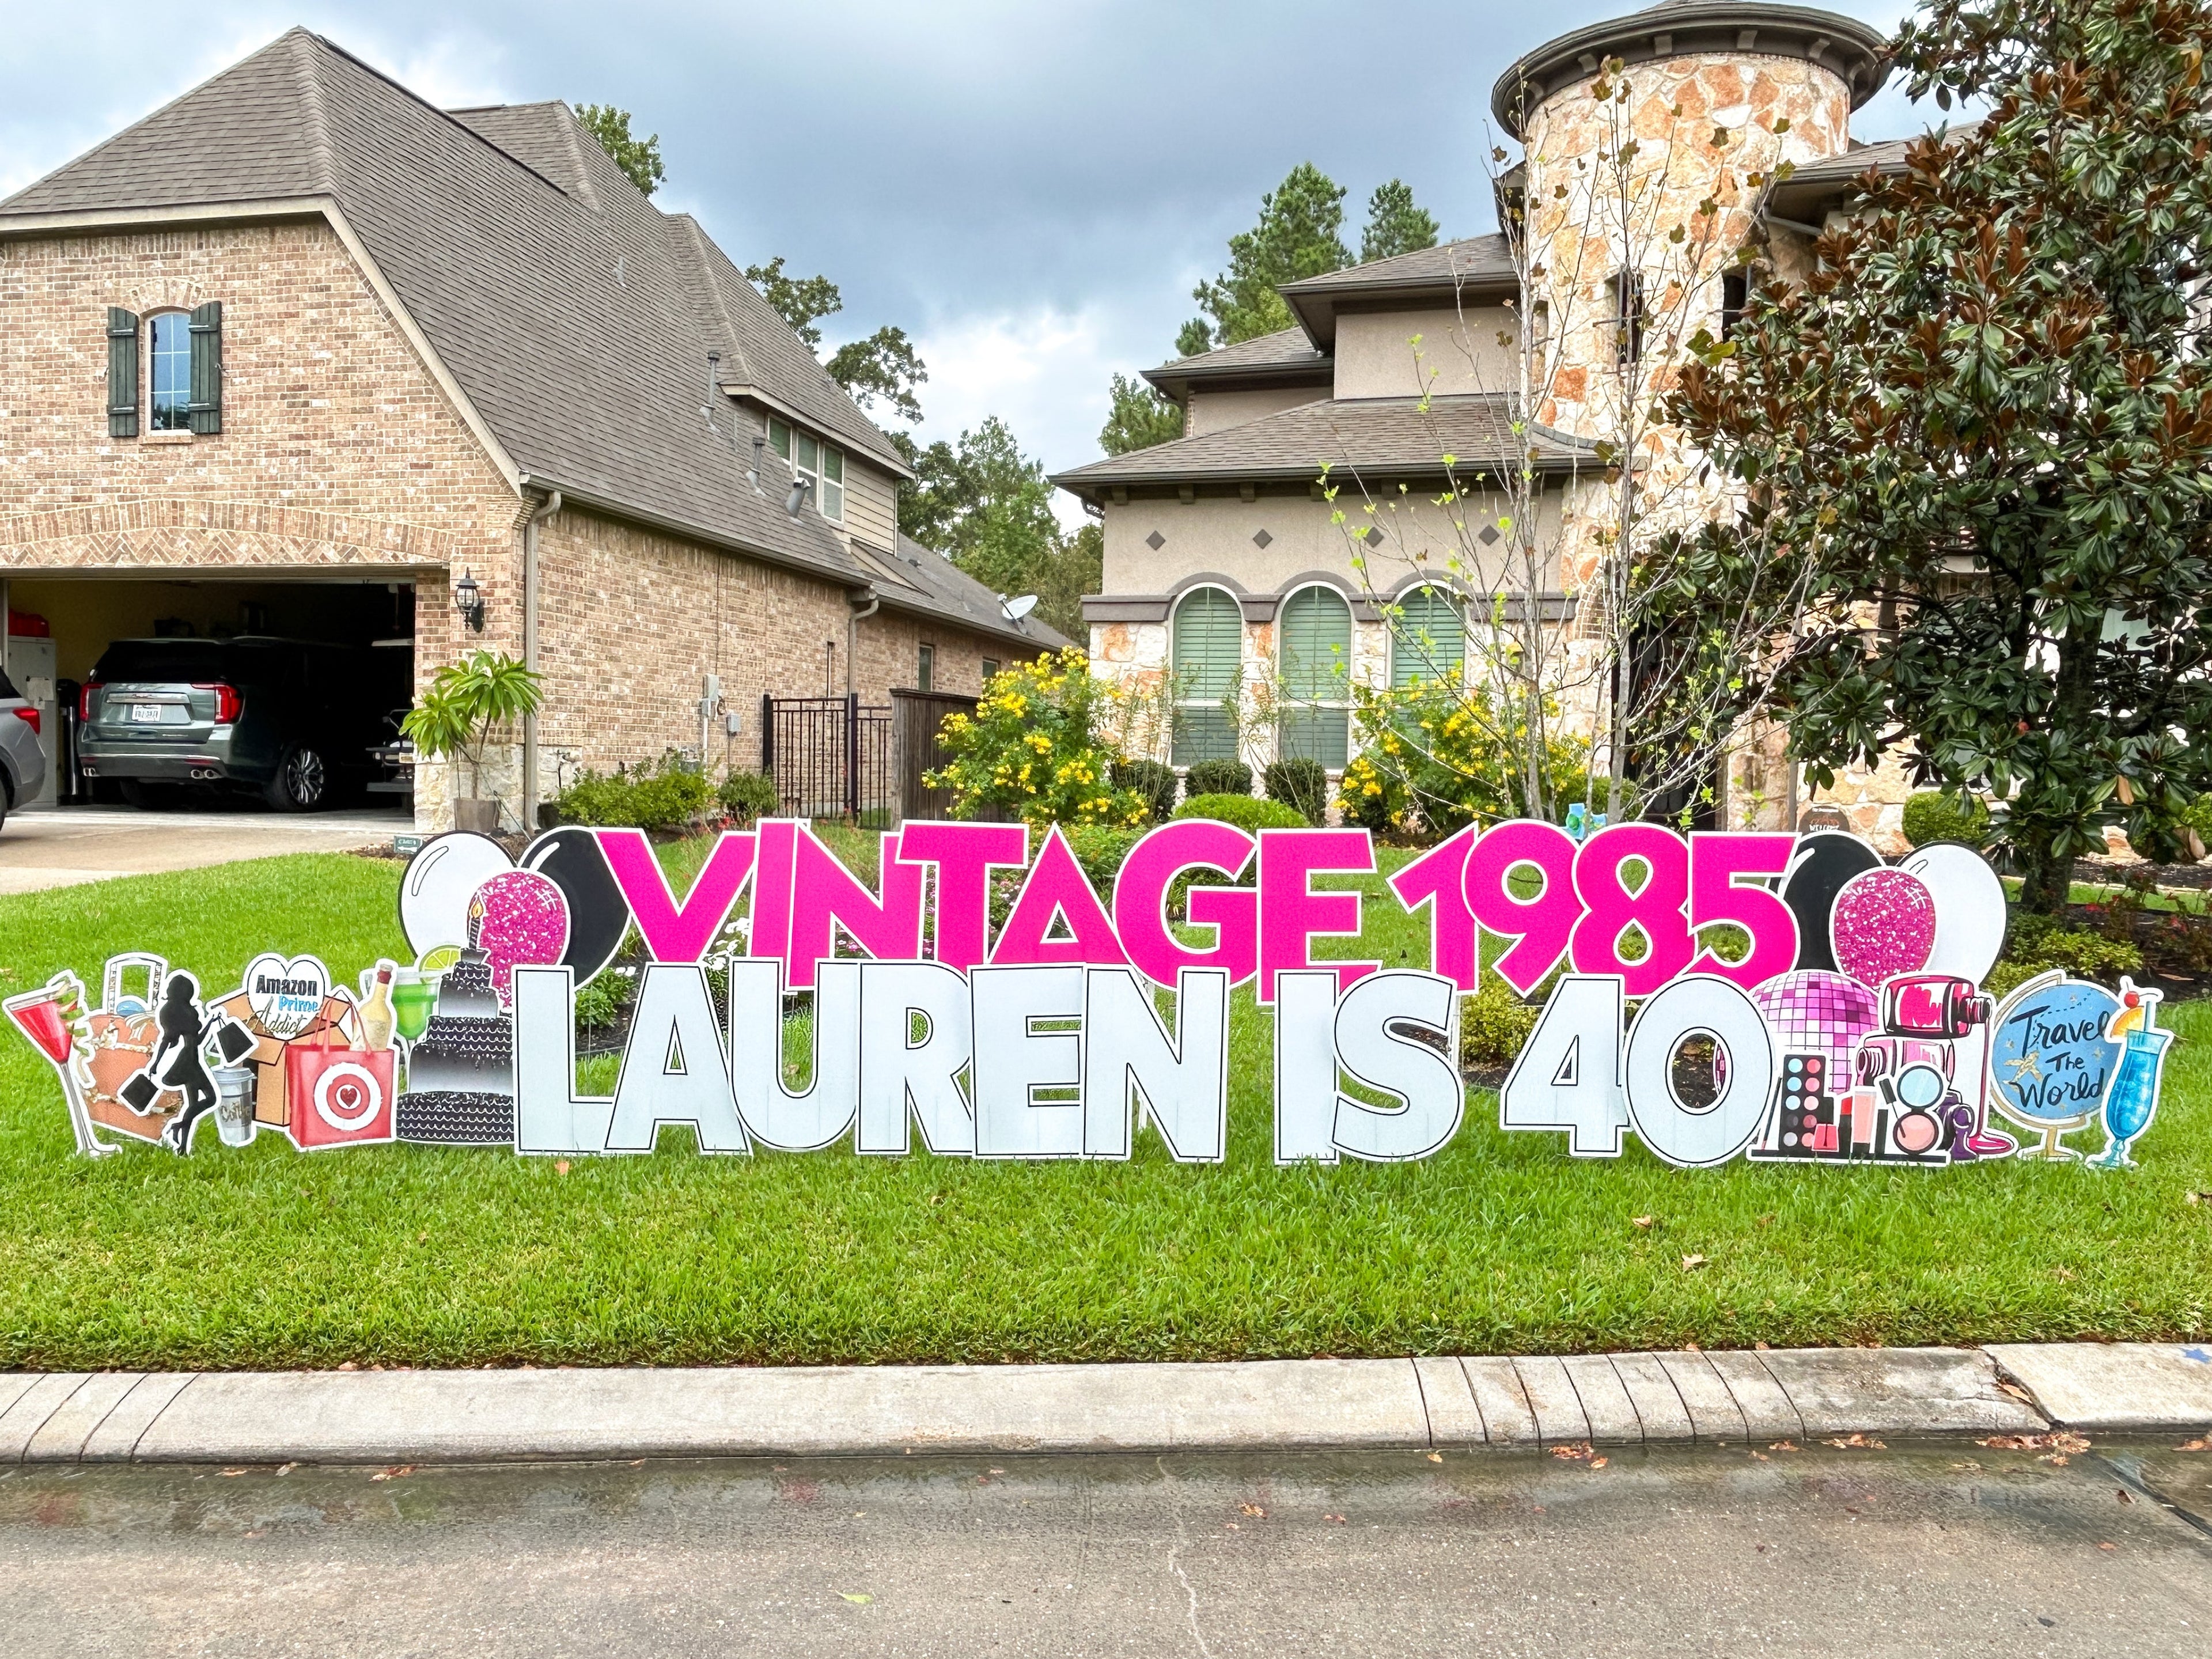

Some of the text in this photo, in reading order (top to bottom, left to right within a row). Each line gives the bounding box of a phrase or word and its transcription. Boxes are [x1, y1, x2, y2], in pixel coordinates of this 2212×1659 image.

[591, 818, 1800, 1006] VINTAGE 1985
[256, 975, 317, 996] Amazon
[279, 996, 320, 1012] Prime
[247, 996, 308, 1033] Addict
[2009, 1005, 2111, 1058] Travel
[513, 957, 1777, 1166] LAUREN IS 40
[2046, 1051, 2085, 1072] The
[2009, 1067, 2104, 1108] World
